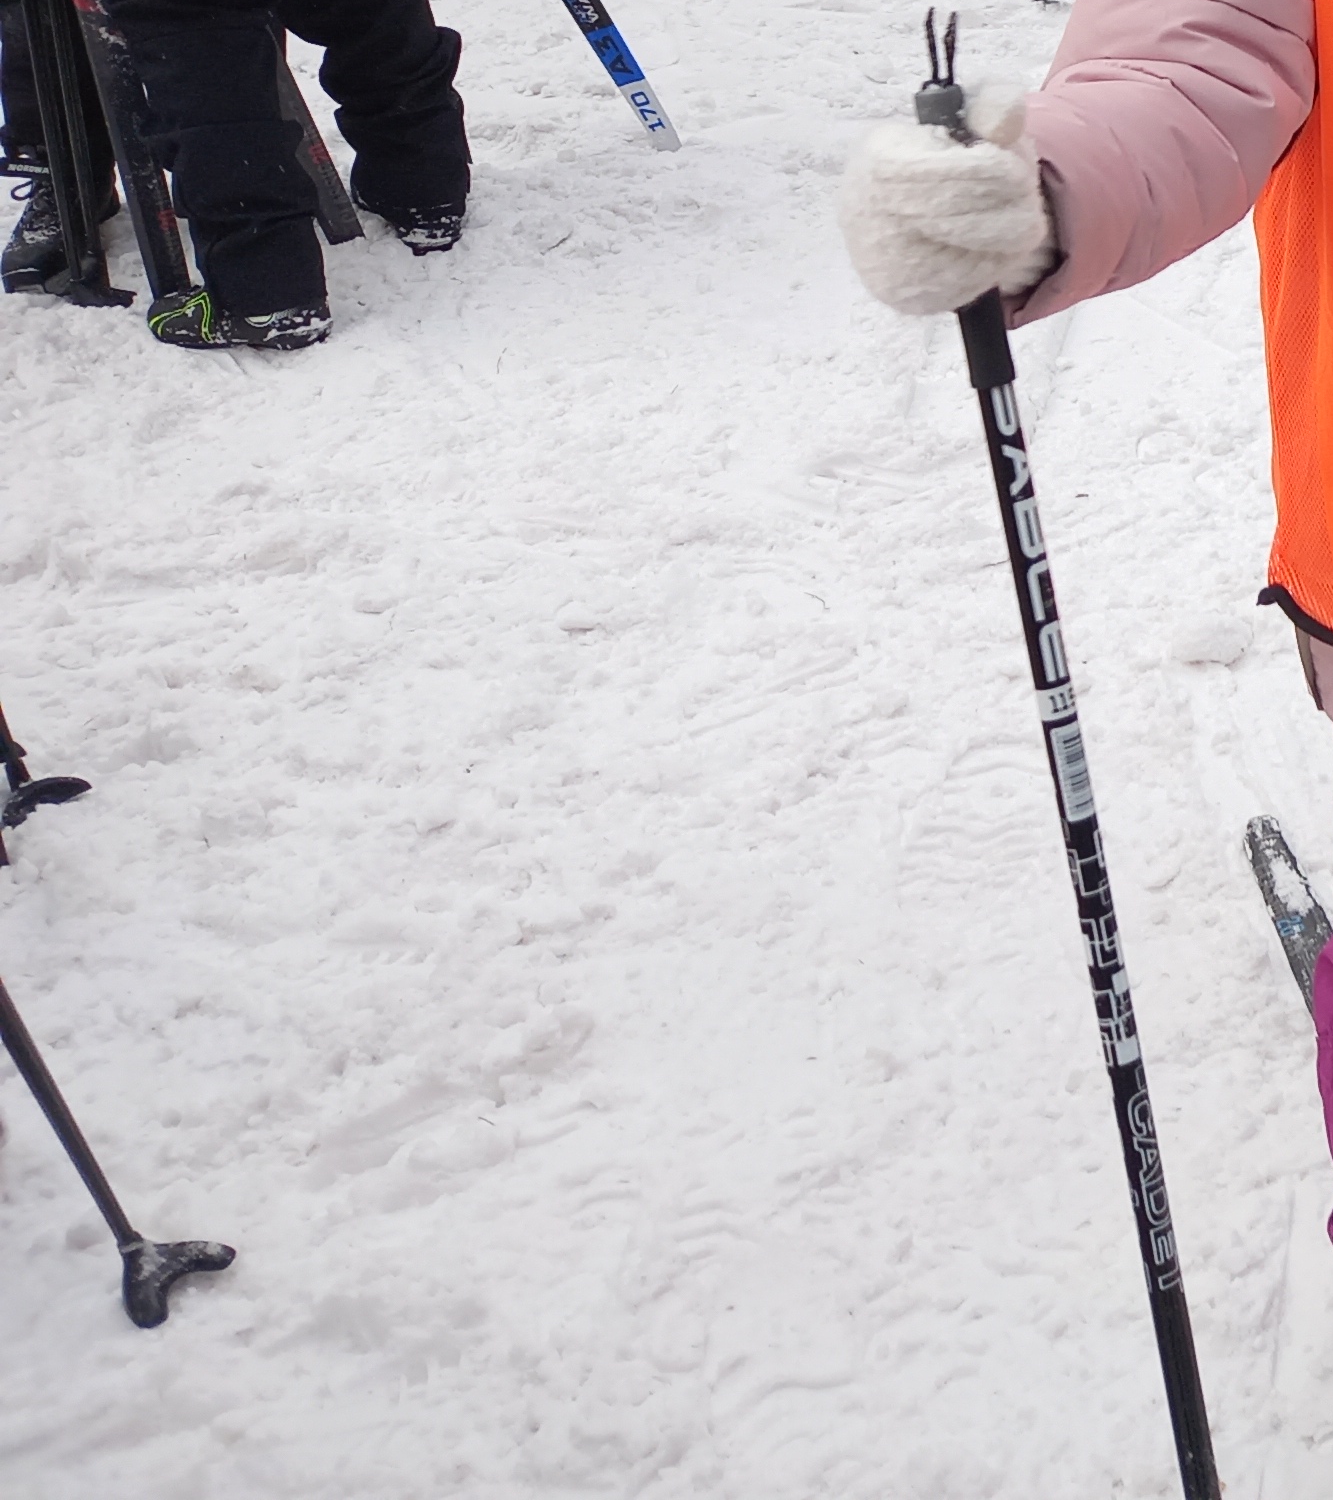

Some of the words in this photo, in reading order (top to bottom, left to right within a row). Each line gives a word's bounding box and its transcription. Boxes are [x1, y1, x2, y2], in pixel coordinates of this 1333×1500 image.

[592, 34, 635, 76] A3
[630, 90, 667, 133] 170
[990, 385, 1071, 683] SABLE
[1126, 1089, 1185, 1293] CADET
